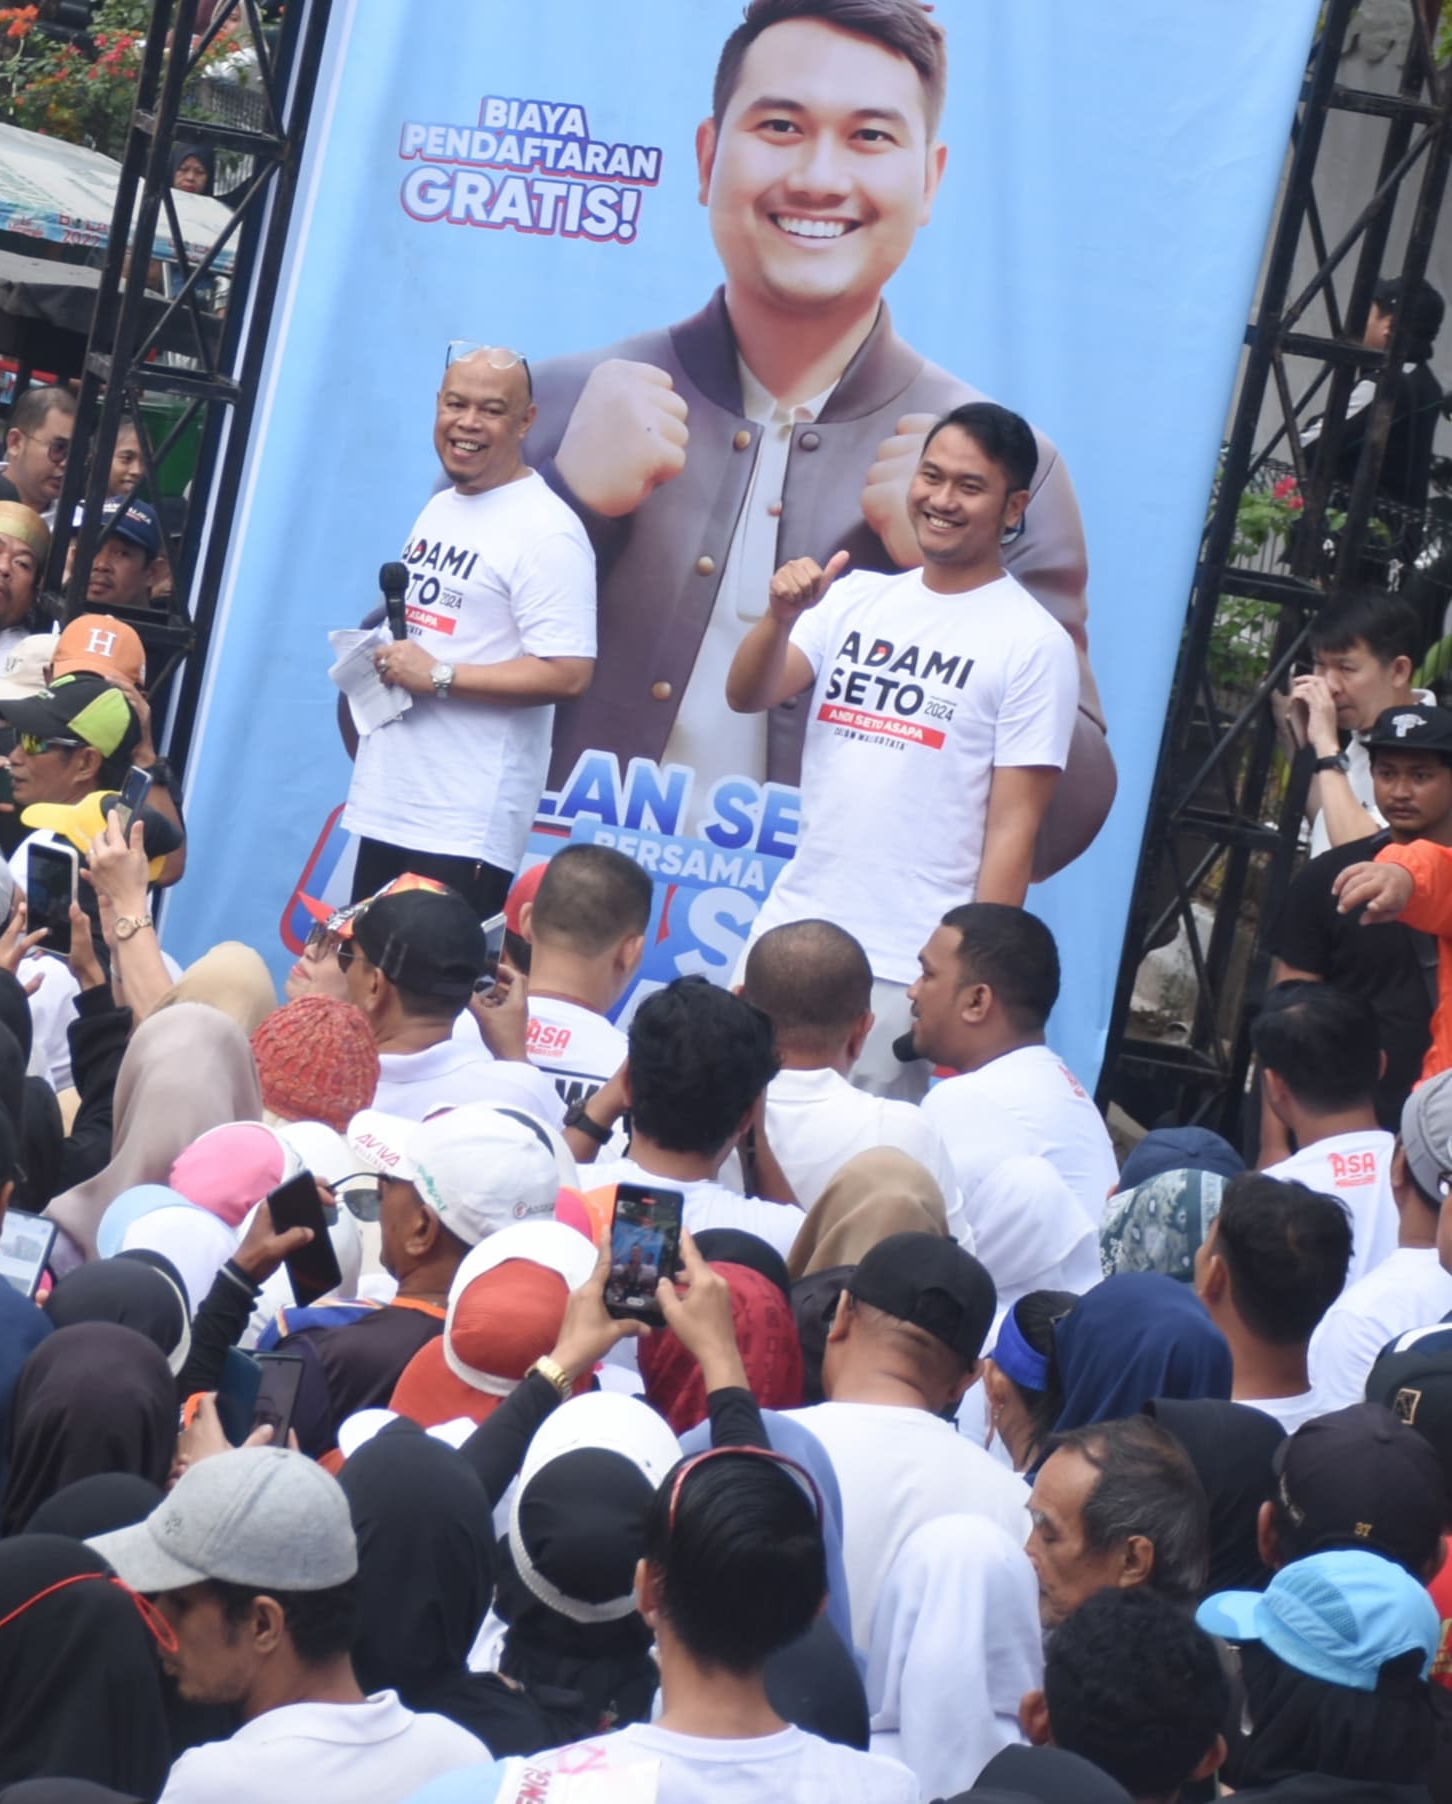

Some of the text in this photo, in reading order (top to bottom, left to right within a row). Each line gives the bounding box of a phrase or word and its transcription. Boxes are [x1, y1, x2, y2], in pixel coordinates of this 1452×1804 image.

[481, 96, 588, 140] BIAYA
[402, 122, 660, 182] PENDAFTARAN
[402, 166, 640, 241] GRATIS!
[407, 572, 441, 606] TO
[84, 628, 117, 658] H
[836, 630, 975, 690] ADAMI
[825, 667, 954, 722] SETO 2024
[854, 714, 883, 731] SETO
[883, 718, 925, 741] ASAPA
[526, 1018, 572, 1049] ASA
[355, 1133, 401, 1168] AVIVA
[1328, 1152, 1376, 1177] ASA
